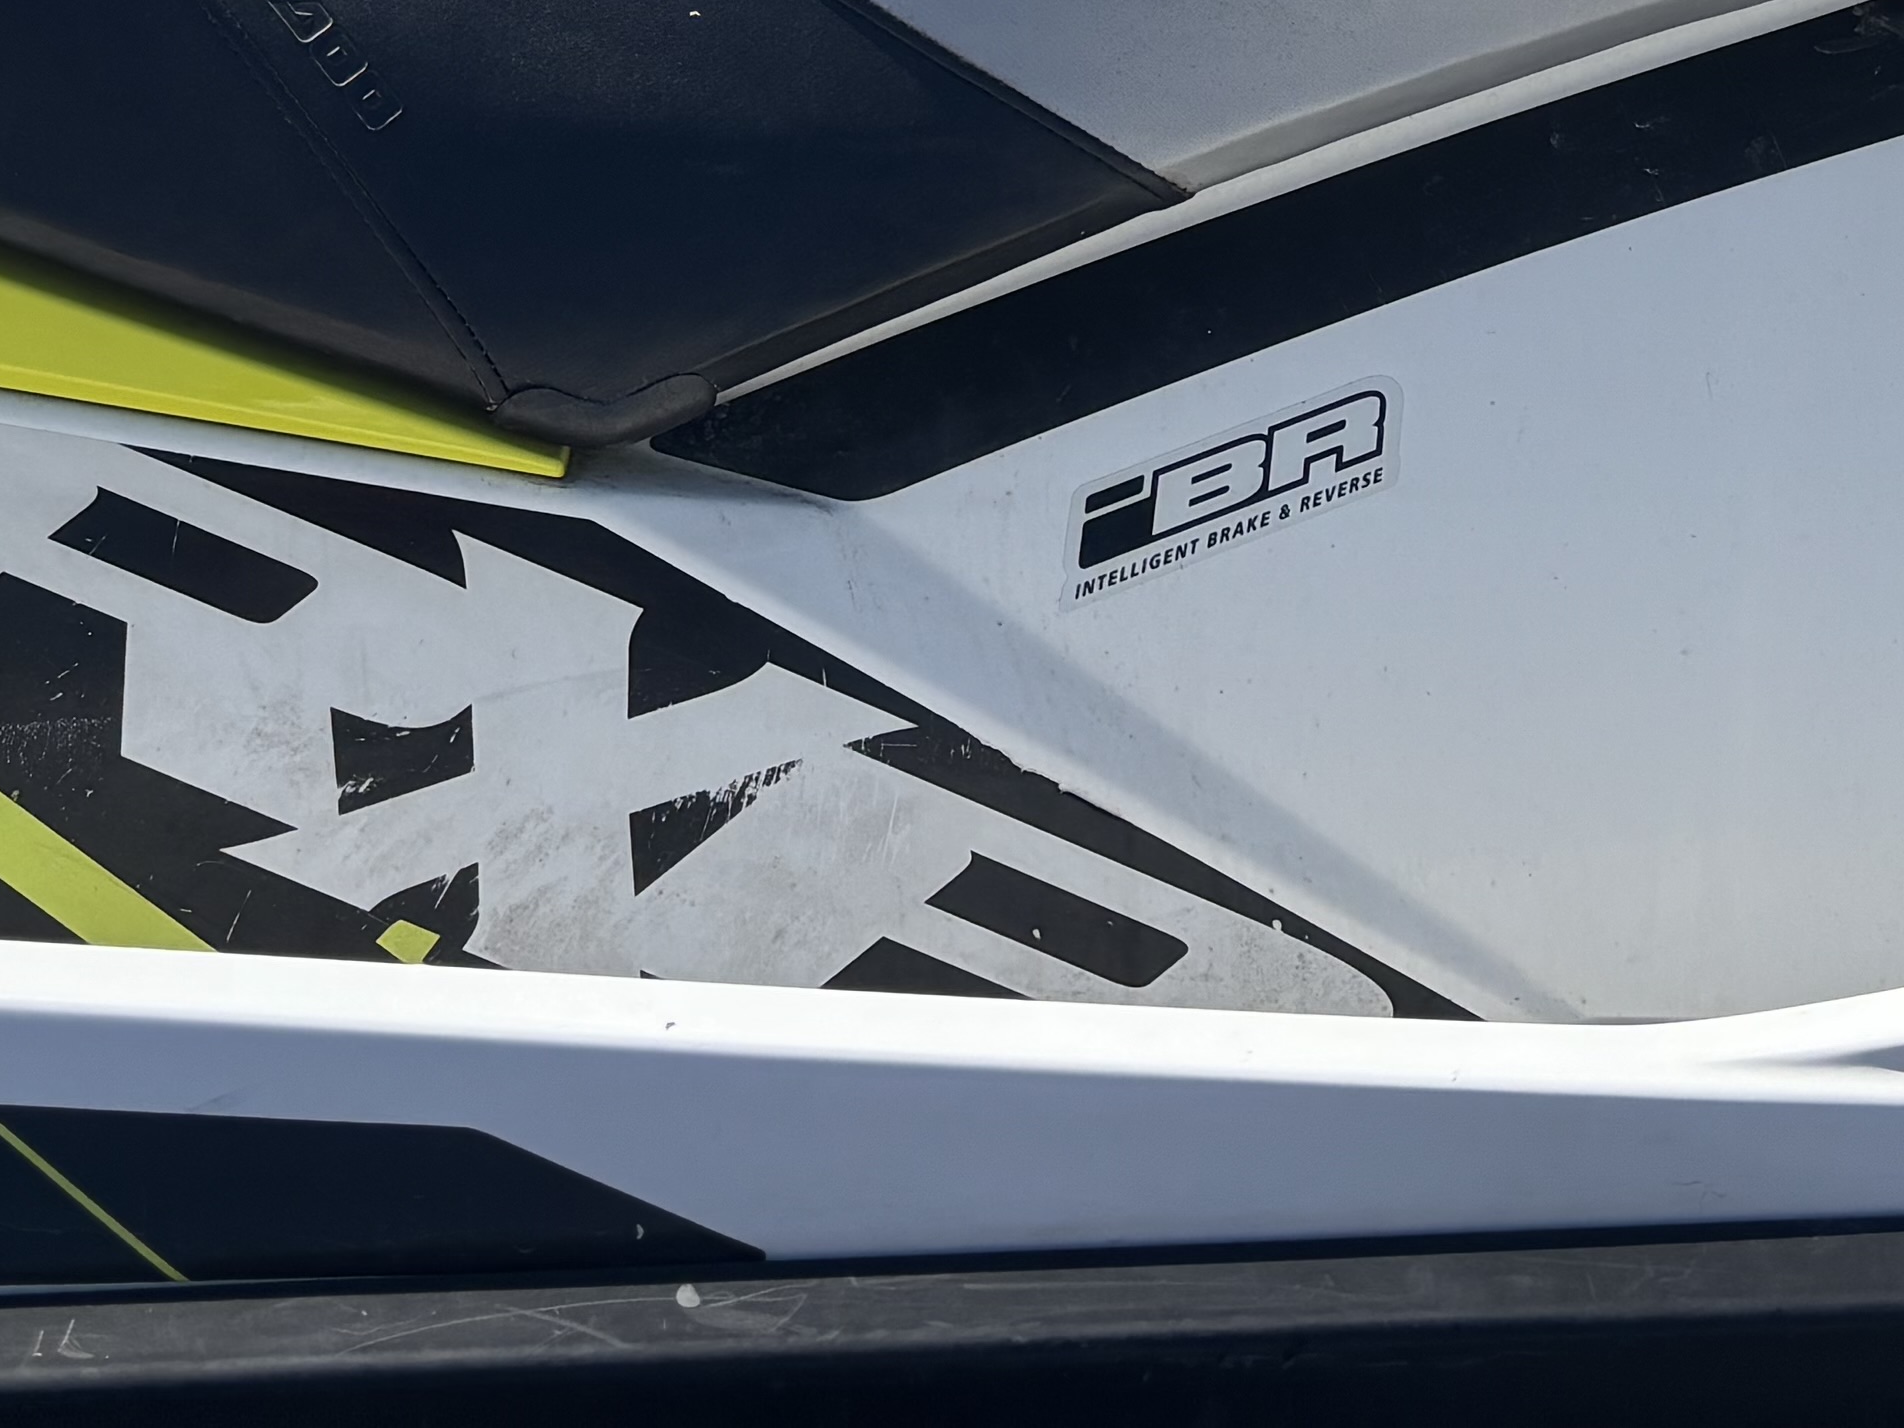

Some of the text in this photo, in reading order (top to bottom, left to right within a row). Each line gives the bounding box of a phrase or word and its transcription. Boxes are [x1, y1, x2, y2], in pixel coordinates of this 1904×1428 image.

[1074, 467, 1384, 600] INTELLIGENT BRAKE & REVERSE
